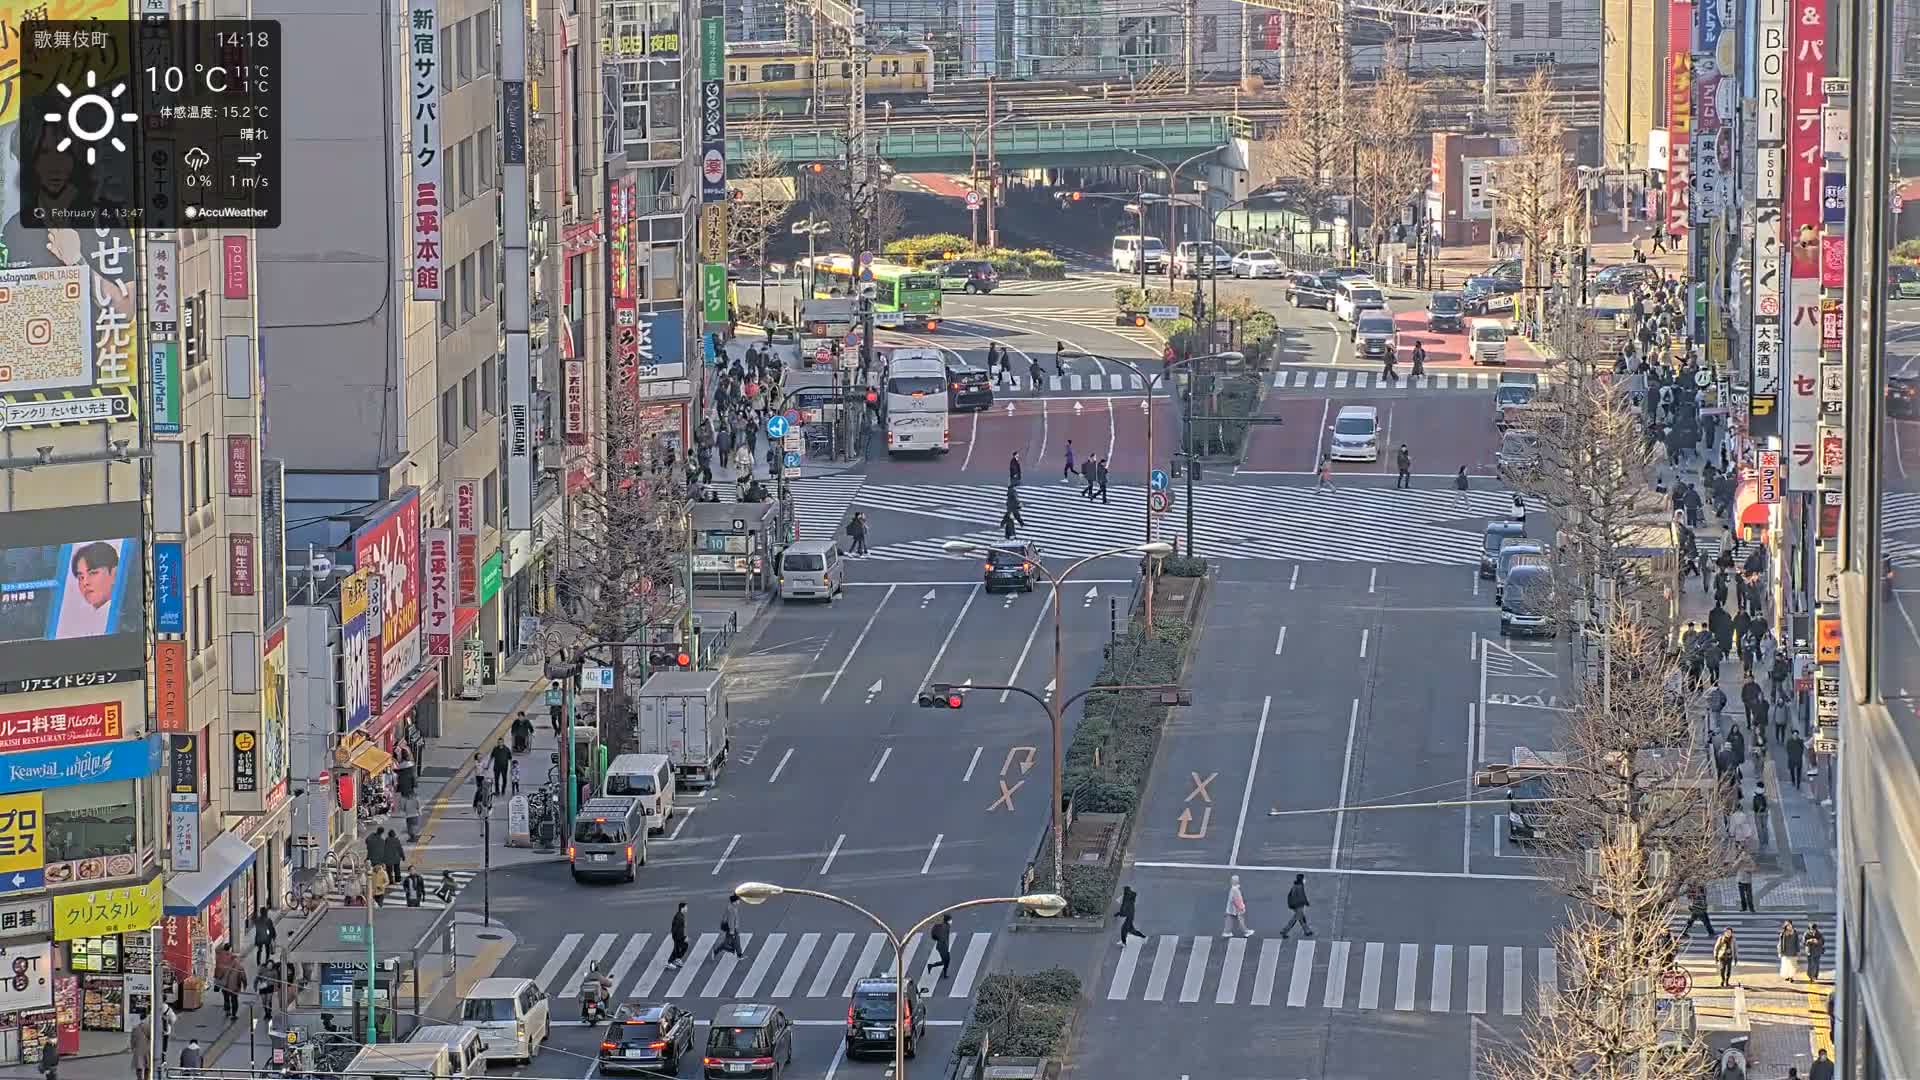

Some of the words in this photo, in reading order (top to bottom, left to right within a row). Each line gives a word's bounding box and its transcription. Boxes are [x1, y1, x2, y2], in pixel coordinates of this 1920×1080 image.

[650, 34, 678, 52] 夜間
[413, 9, 436, 167] 新宿サンパーク
[1765, 150, 1775, 197] ESOLA
[416, 183, 439, 289] 三平本館
[708, 204, 720, 261] 肉汁水餃子
[708, 273, 720, 311] レイク
[1757, 327, 1771, 379] 大衆酒場
[152, 351, 166, 412] FamilyMart
[51, 402, 109, 418] たいせい先生
[459, 485, 469, 528] GAME
[430, 540, 447, 627] 三平ストア
[22, 734, 66, 745] RESTAURANT
[0, 833, 37, 855] ミス
[2, 909, 36, 929] 囲碁
[67, 901, 139, 926] クリスタル
[330, 961, 382, 970] SUBNAE
[324, 990, 340, 1002] 12
